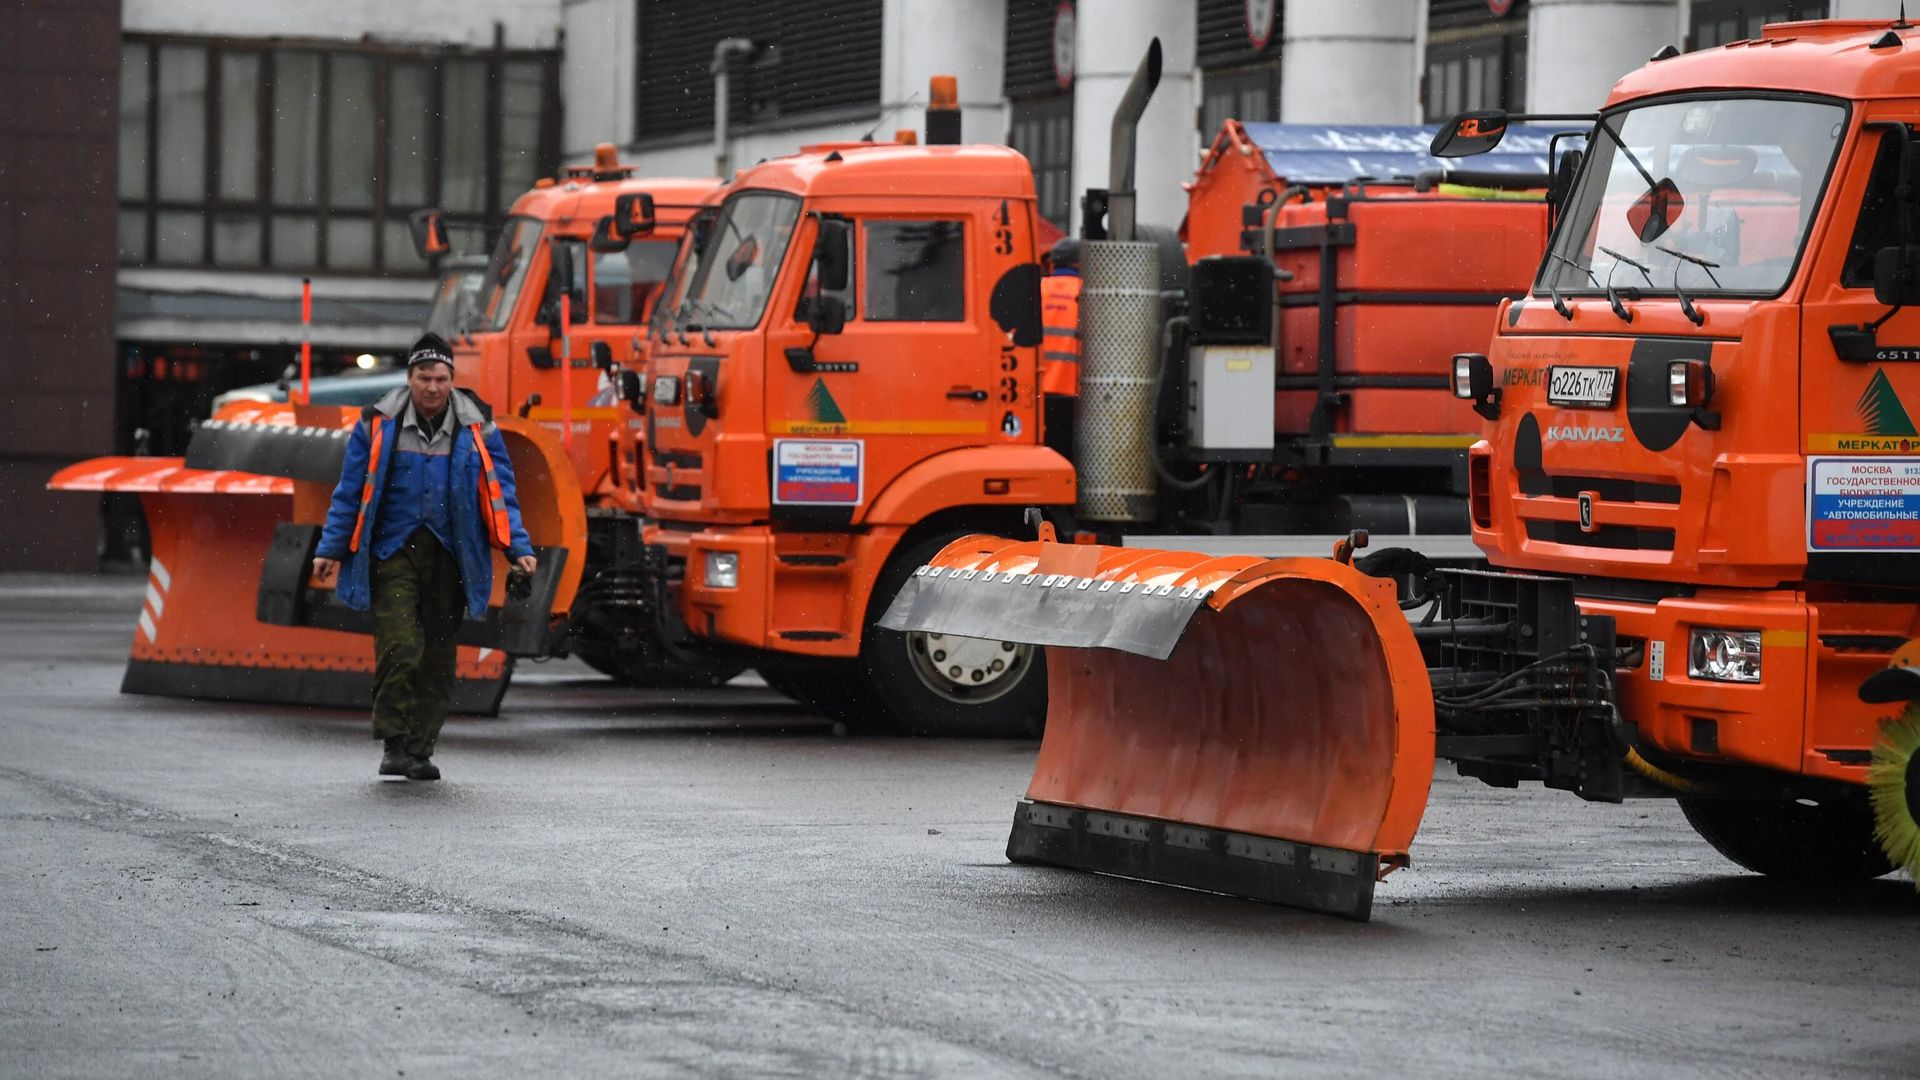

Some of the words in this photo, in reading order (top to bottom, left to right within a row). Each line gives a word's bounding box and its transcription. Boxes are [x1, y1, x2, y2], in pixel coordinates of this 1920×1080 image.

[1503, 367, 1549, 392] МЕРКАТ
[1597, 370, 1613, 390] 777
[1547, 426, 1625, 442] KAMAZ
[1851, 465, 1893, 475] МОСКВА
[1837, 499, 1905, 509] УЧРЕЖДЕНИЕ
